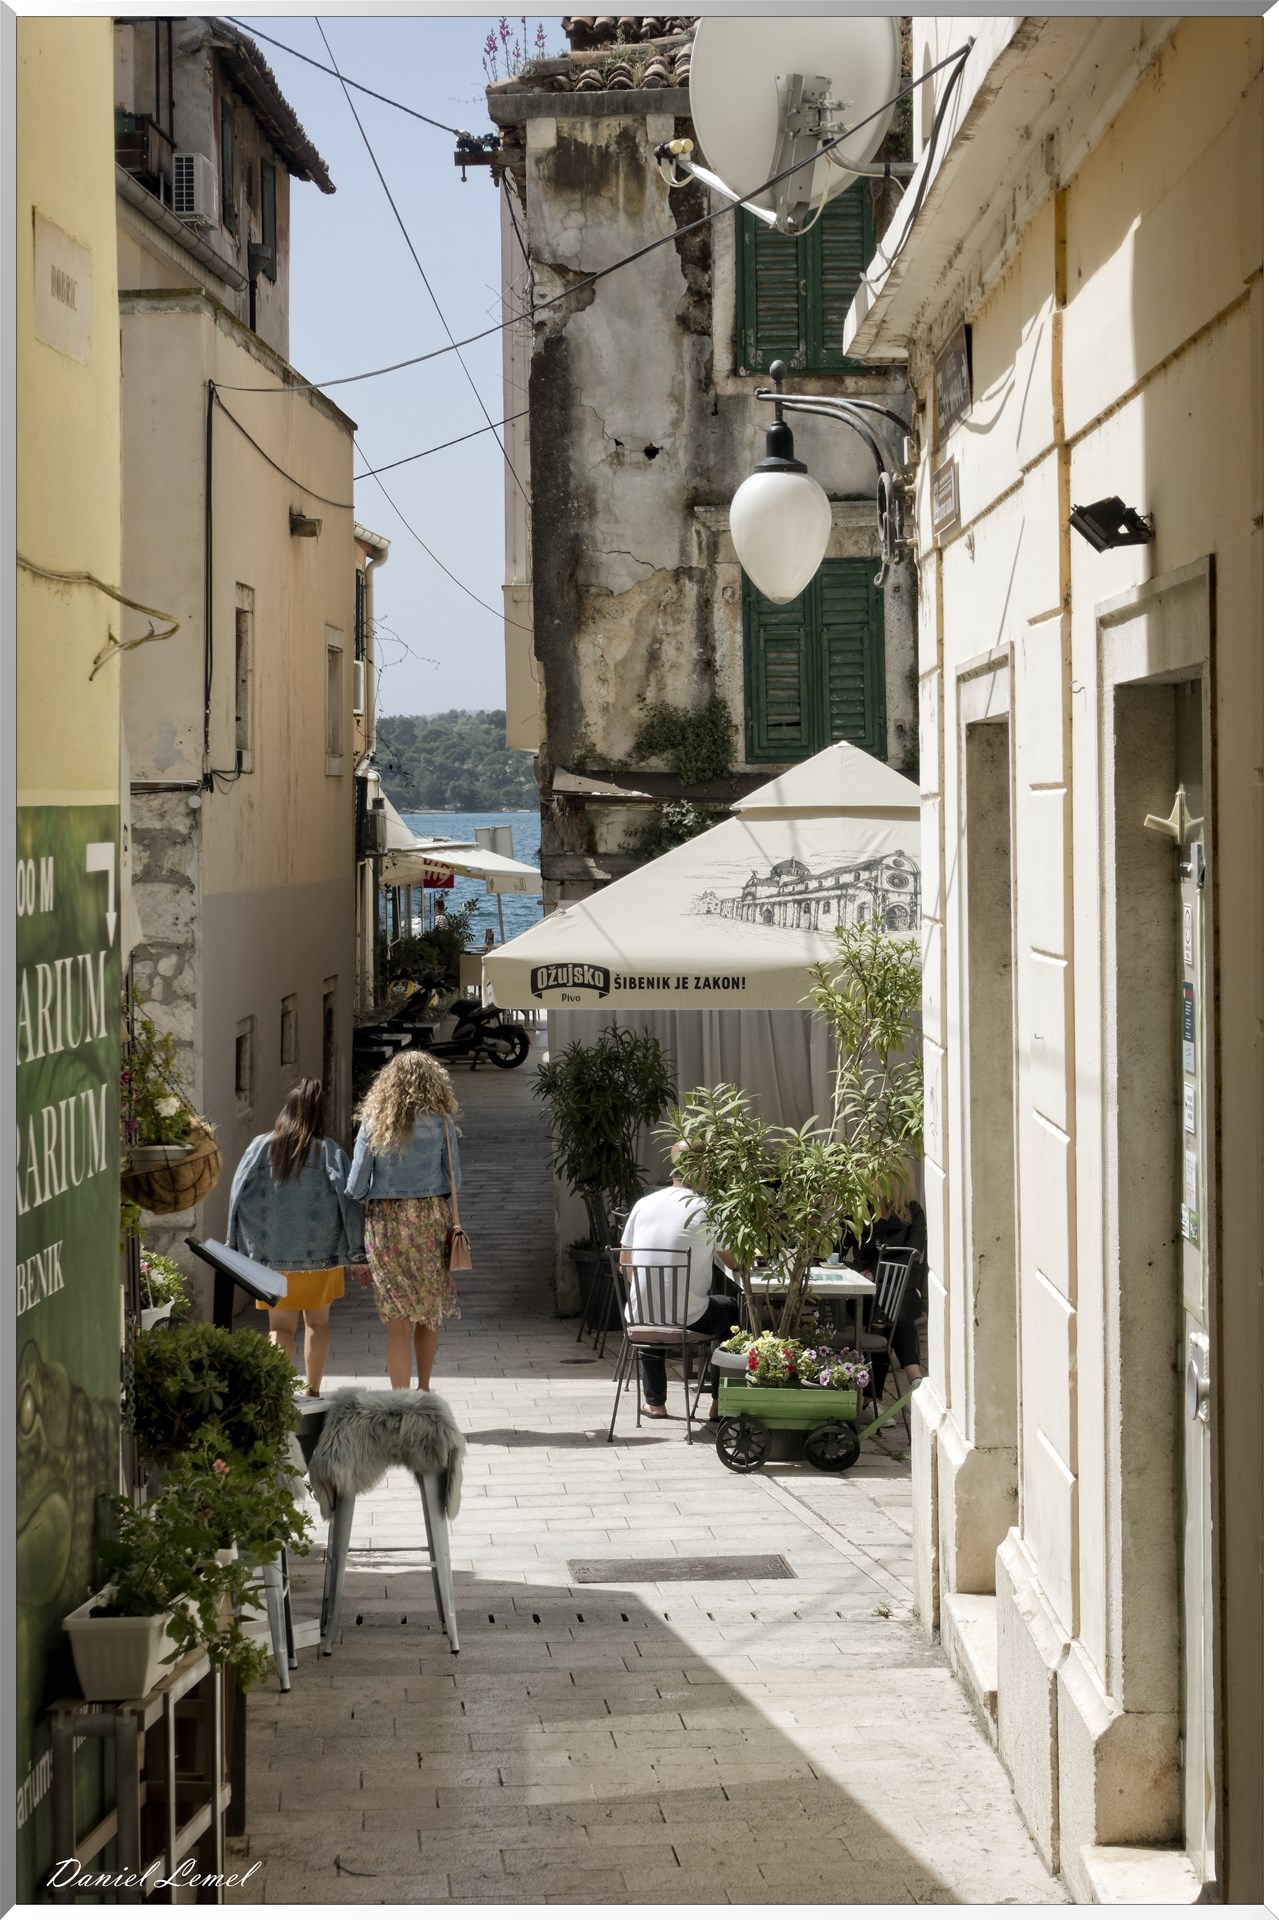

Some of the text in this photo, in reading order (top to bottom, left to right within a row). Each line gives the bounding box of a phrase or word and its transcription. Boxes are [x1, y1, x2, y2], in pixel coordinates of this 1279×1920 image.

[17, 856, 54, 917] 00 M
[16, 950, 108, 1066] ARIUM
[536, 964, 604, 989] Ožujsko
[613, 973, 746, 990] ŠIBENIK JE ZAKON!
[16, 1239, 65, 1317] BENIK
[16, 1746, 53, 1830] arium
